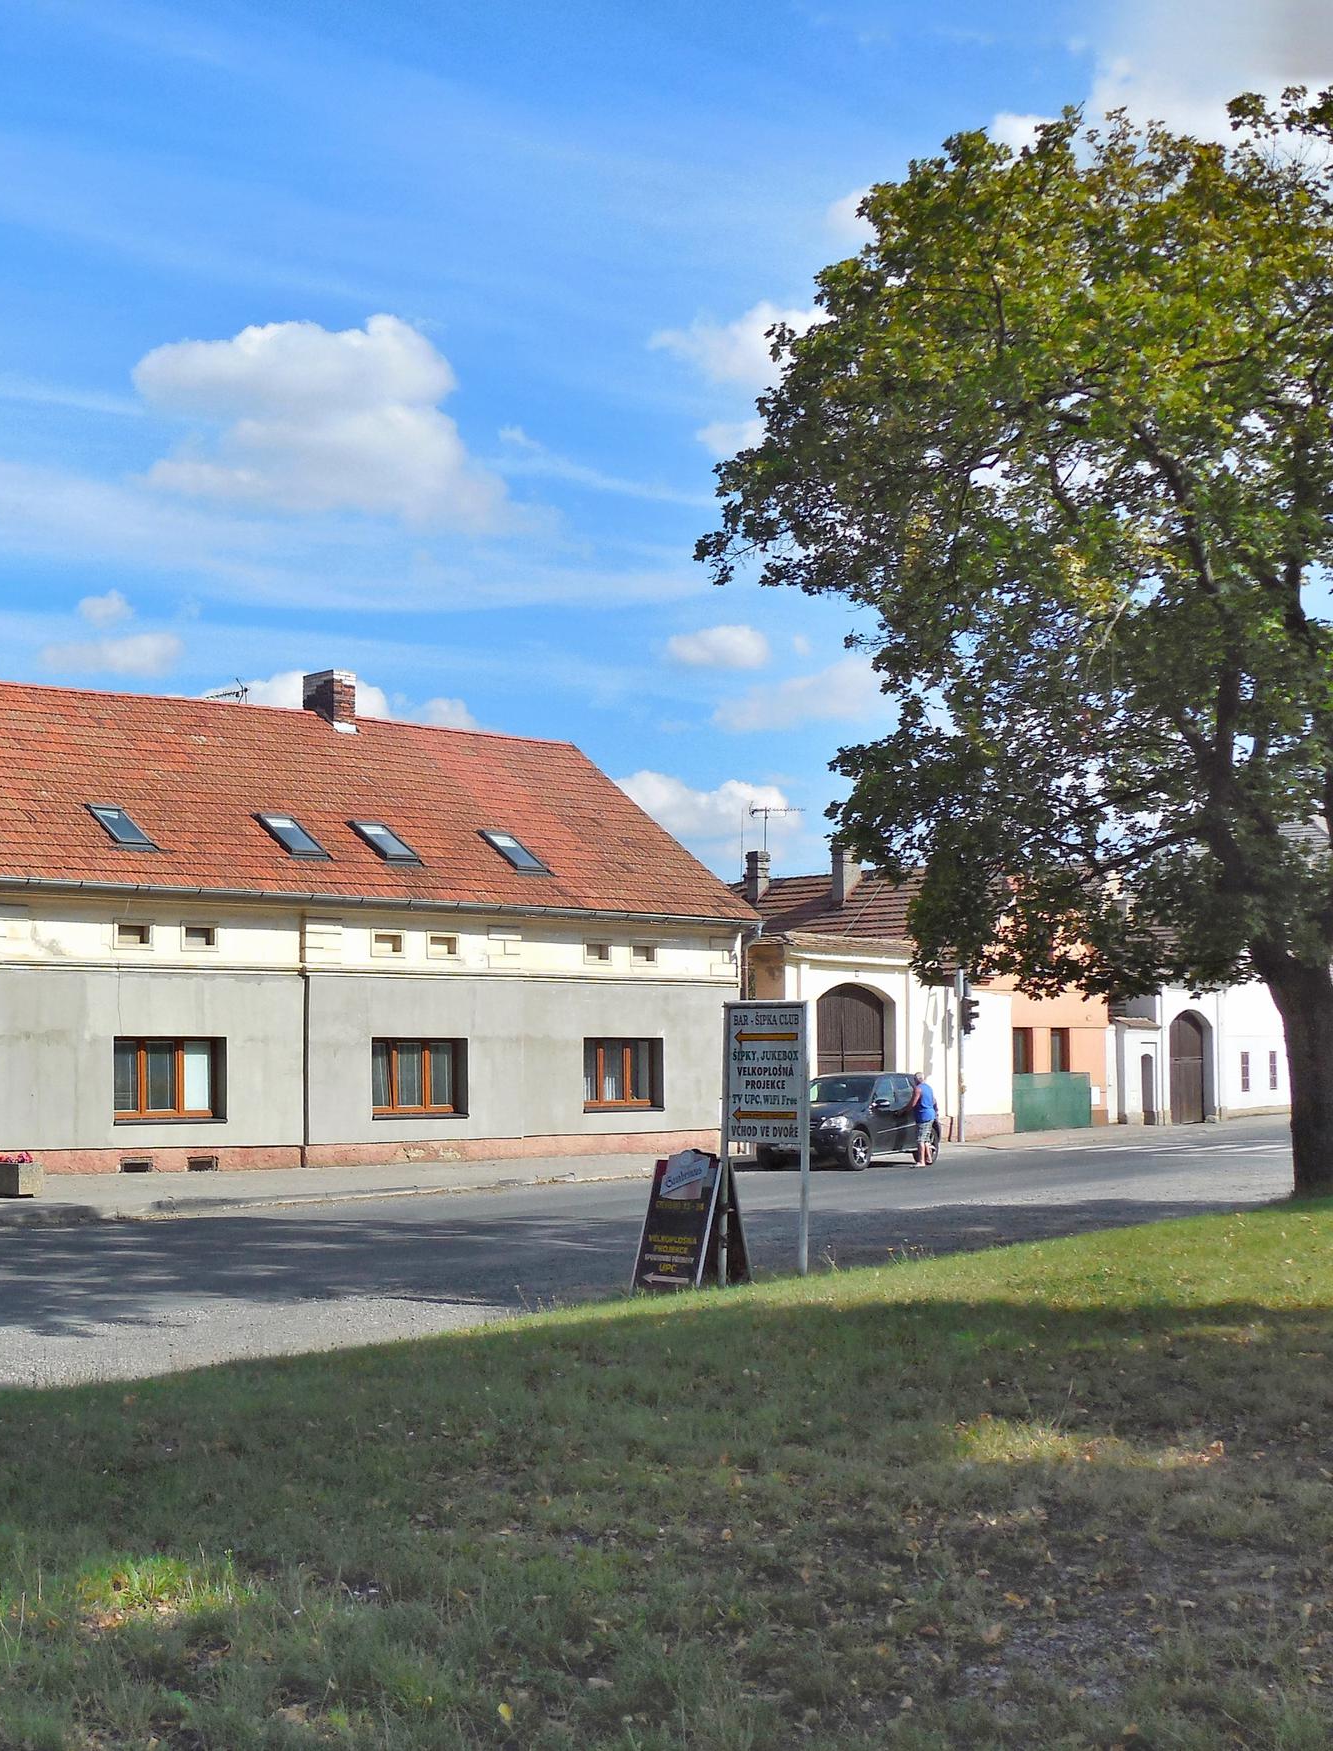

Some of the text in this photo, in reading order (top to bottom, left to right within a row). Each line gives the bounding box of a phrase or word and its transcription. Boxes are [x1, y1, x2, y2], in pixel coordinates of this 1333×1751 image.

[733, 1014, 749, 1026] BAR
[754, 1011, 777, 1026] ŠIPKA
[779, 1014, 799, 1025] CLUB
[732, 1048, 799, 1062] ŠIPKY, JUKEBOX
[737, 1064, 794, 1077] VELKOPLOŠNÁ
[745, 1080, 786, 1090] PROJEKCE
[732, 1094, 743, 1104] TV
[731, 1124, 799, 1138] VCHOD VE DVOŘE
[659, 1263, 677, 1273] UPC
